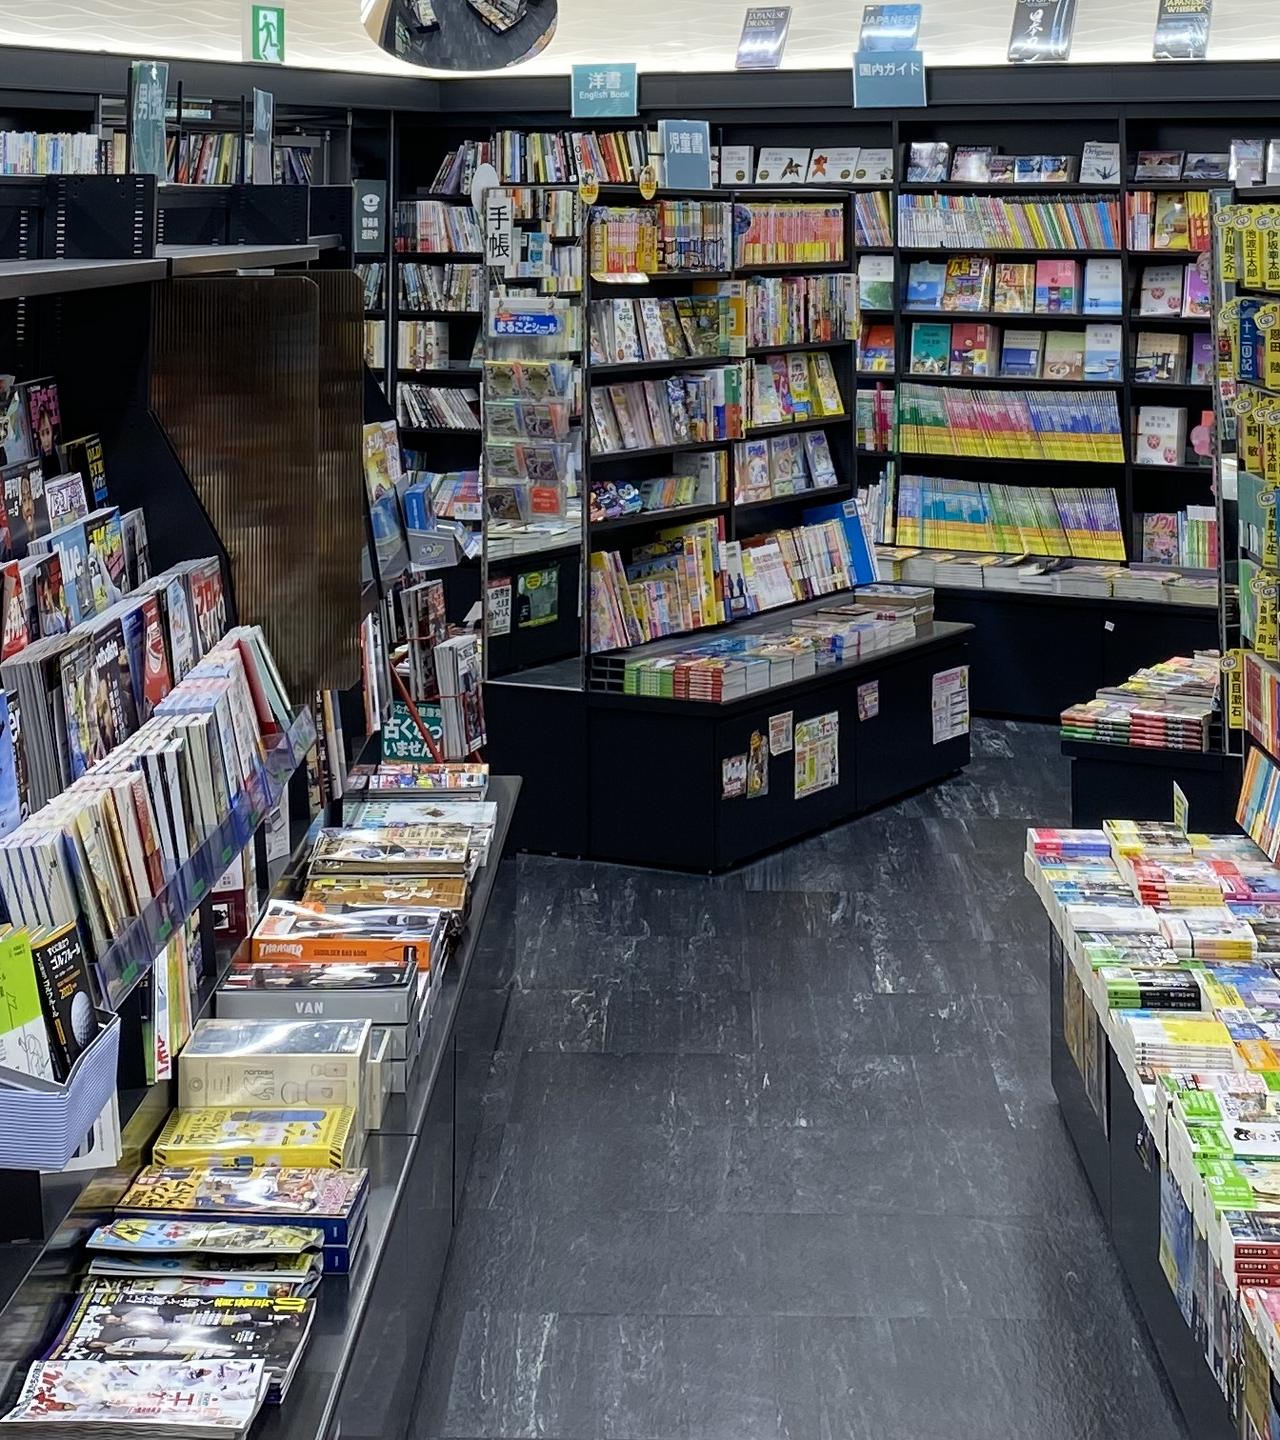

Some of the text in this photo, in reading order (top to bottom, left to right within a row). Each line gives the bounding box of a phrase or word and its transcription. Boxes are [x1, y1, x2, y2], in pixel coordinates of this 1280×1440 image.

[1167, 4, 1203, 13] WHISKY
[860, 63, 919, 76] 国内ガイド
[588, 72, 621, 89] 洋書
[579, 90, 609, 101] English
[669, 131, 703, 154] 児童書
[488, 205, 510, 258] 手帳
[1241, 320, 1253, 372] 十二国記
[1231, 671, 1243, 718] 夏目漱石
[51, 942, 81, 971] ゴルフルール
[259, 943, 303, 958] THRASHER
[295, 1002, 324, 1014] VAN
